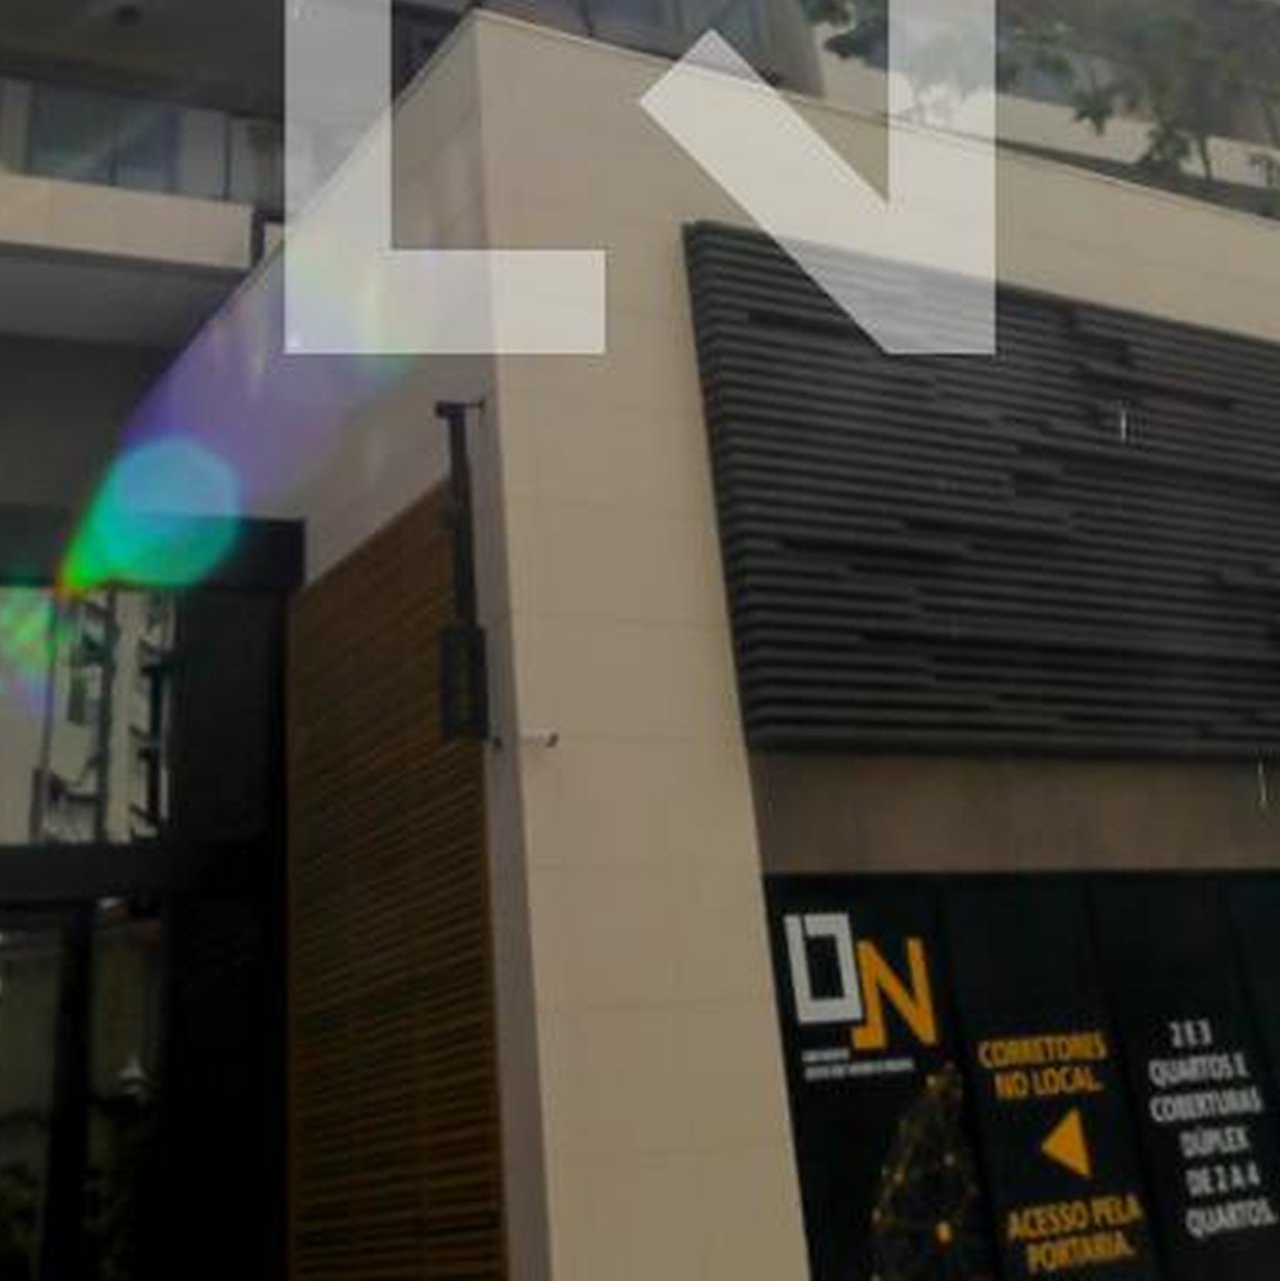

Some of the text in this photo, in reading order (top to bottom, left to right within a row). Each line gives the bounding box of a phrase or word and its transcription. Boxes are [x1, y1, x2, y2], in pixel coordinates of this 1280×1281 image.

[995, 1070, 1029, 1098] NO
[1148, 1054, 1233, 1088] QUARTOS
[1149, 1085, 1263, 1122] COBERTURAS
